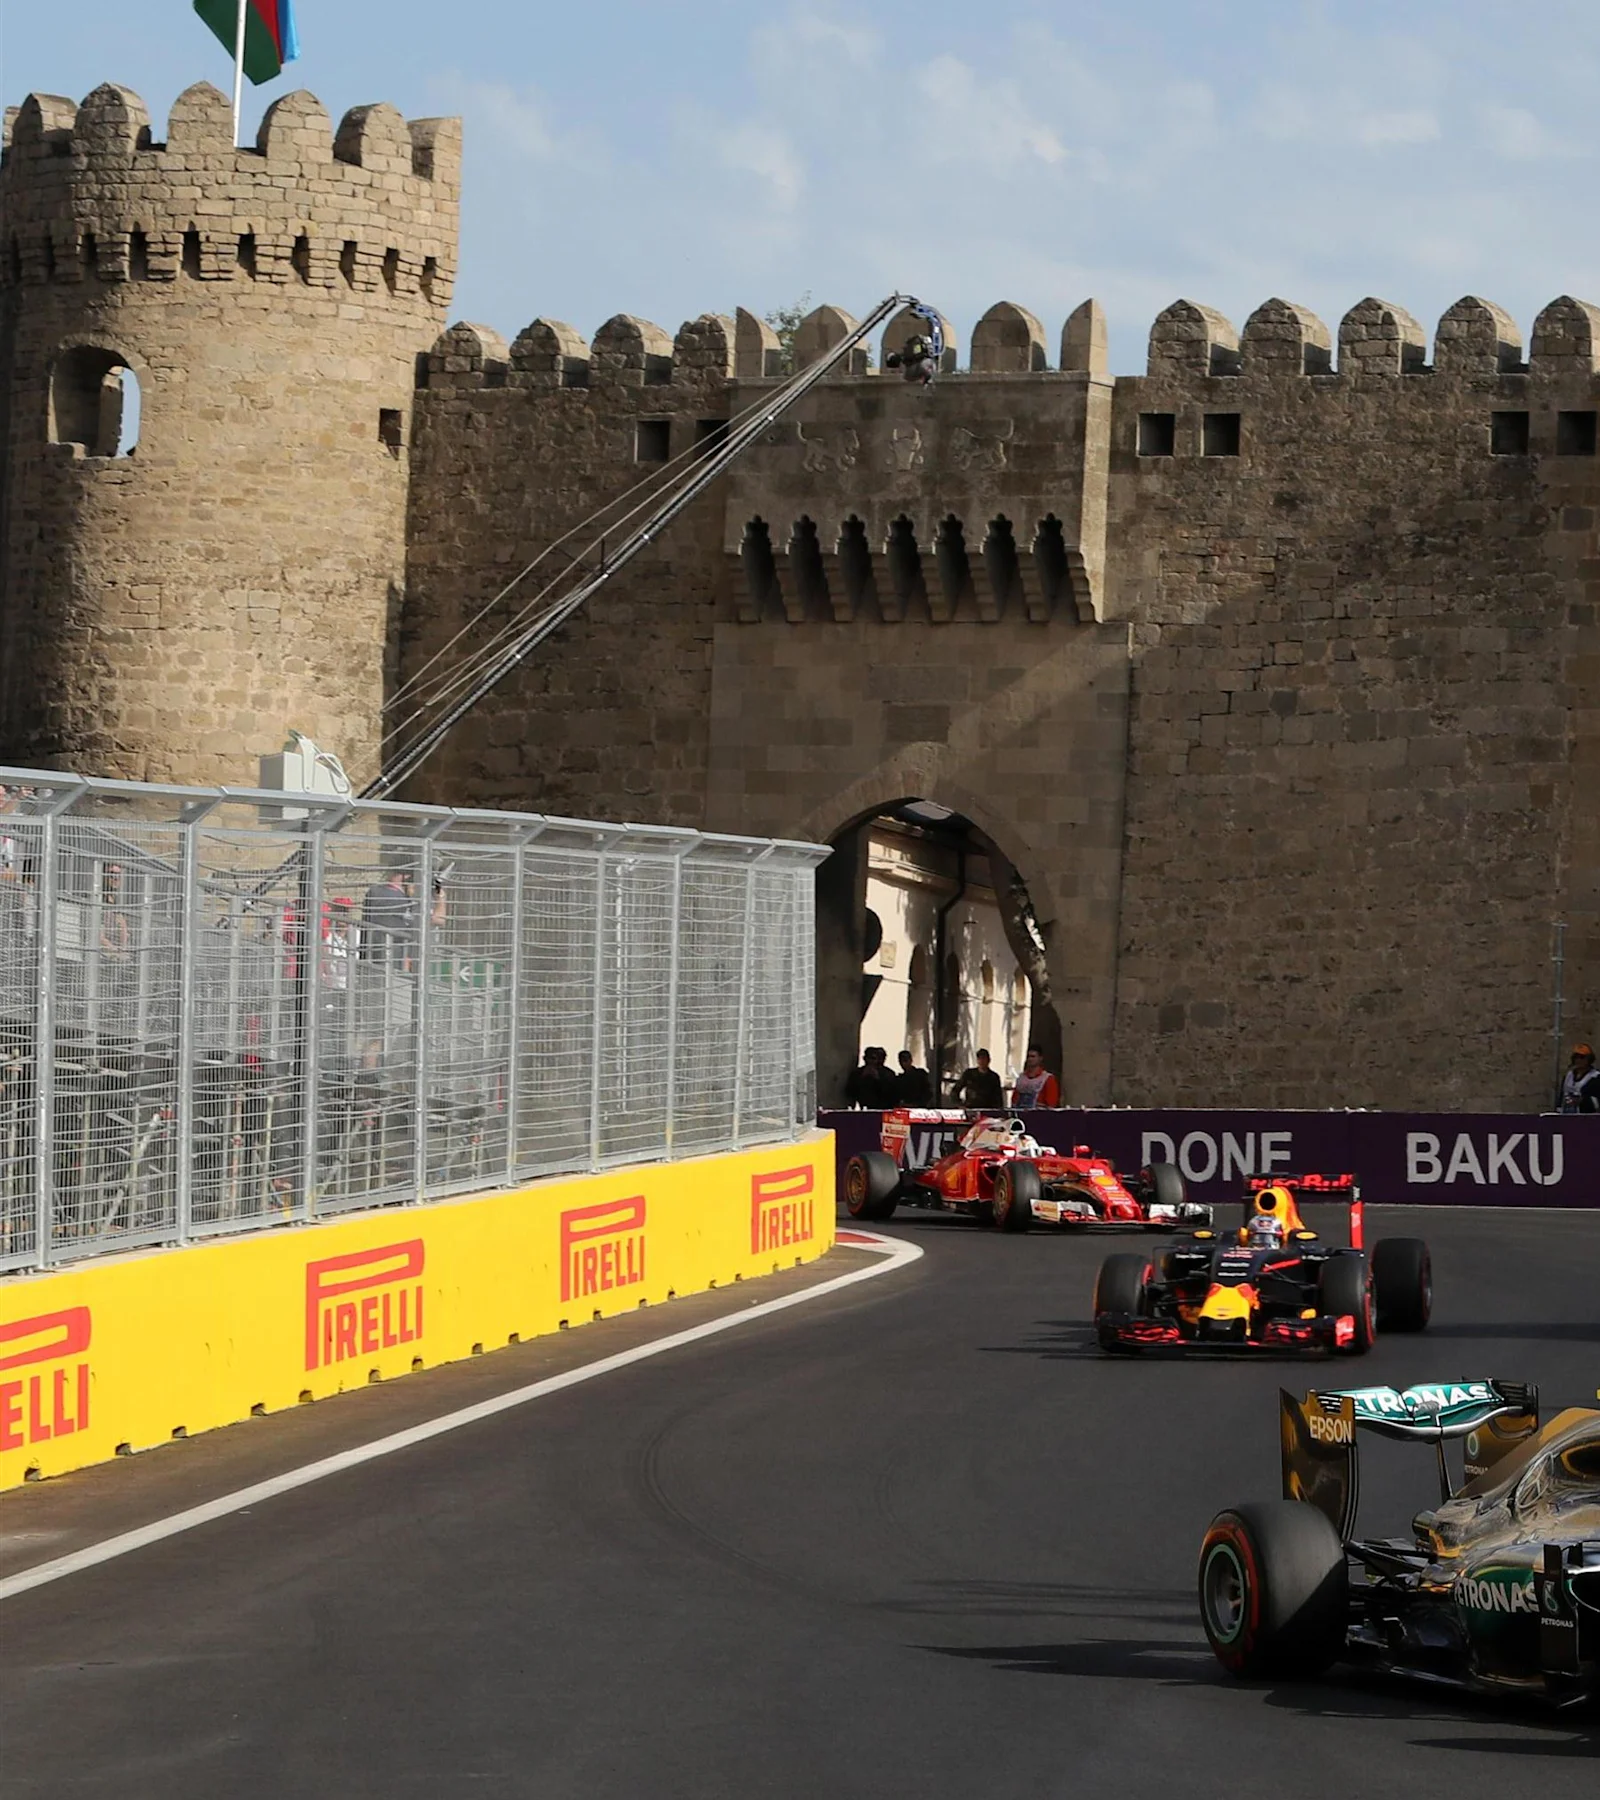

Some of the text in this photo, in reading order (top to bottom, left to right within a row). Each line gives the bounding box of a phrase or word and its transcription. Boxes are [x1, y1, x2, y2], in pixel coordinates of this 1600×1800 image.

[1142, 1131, 1291, 1183] DONE
[1406, 1132, 1563, 1186] BAKU
[752, 1165, 813, 1254] PIRELLI
[561, 1196, 645, 1302] PIRELLI
[305, 1239, 424, 1370] PIRELLI
[1309, 1415, 1352, 1443] EPSON
[1541, 1617, 1574, 1628] PETRONAS
